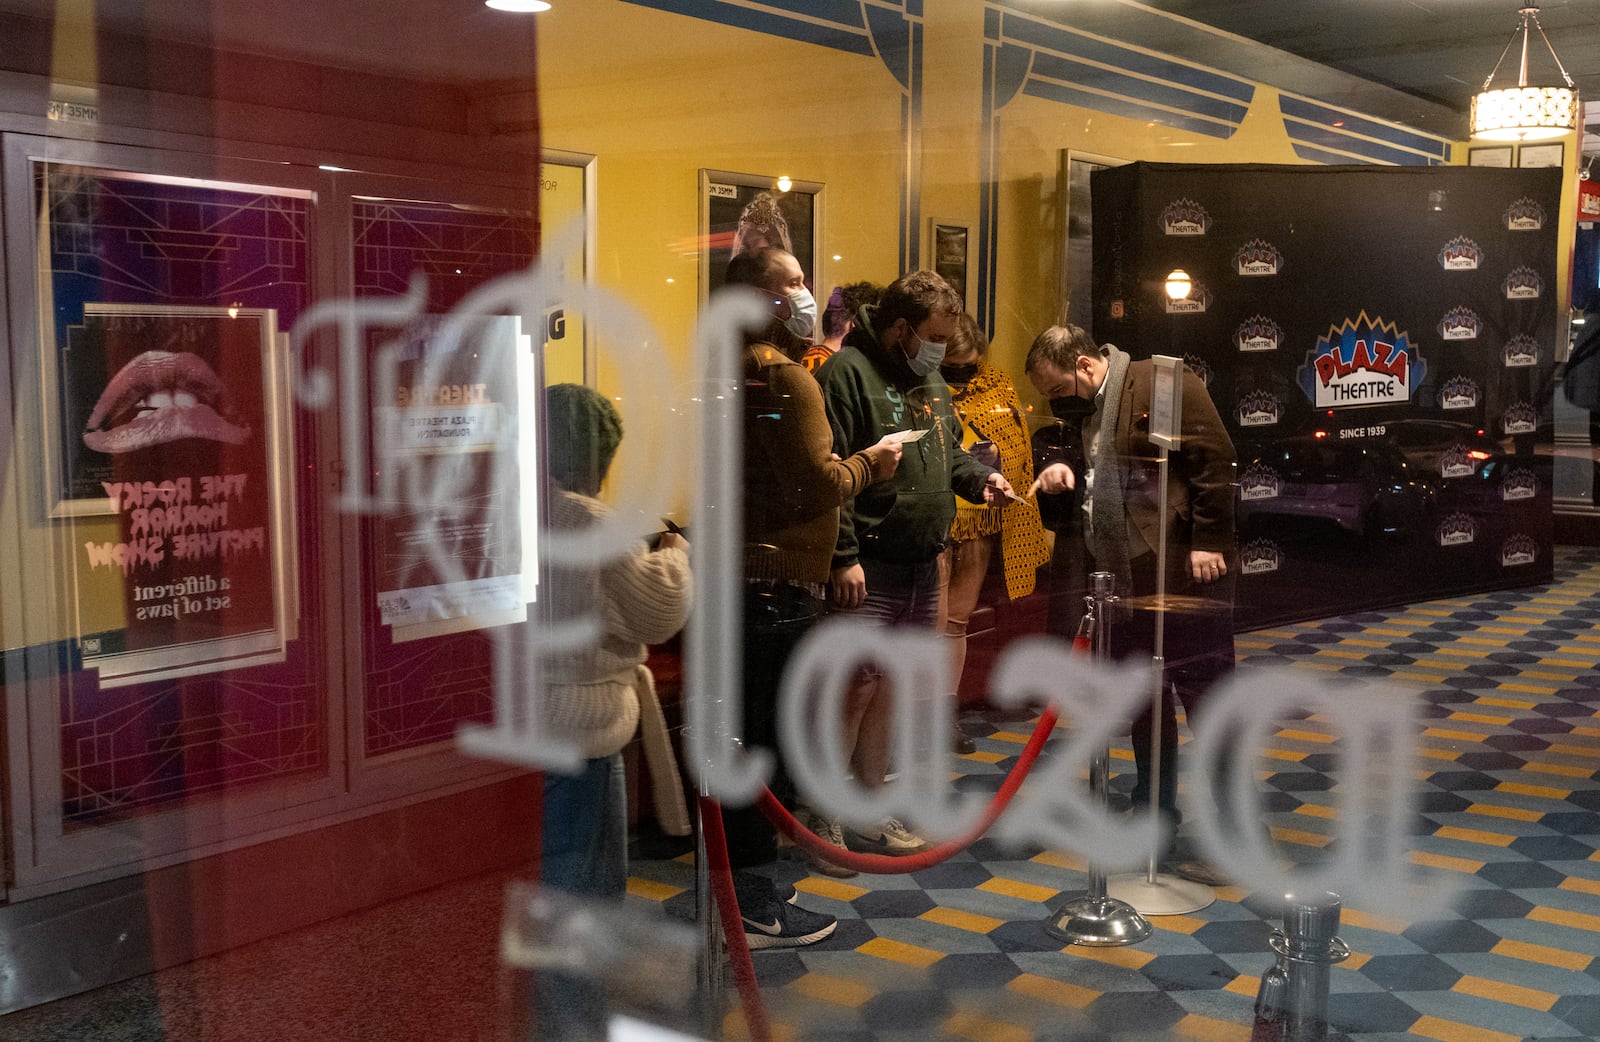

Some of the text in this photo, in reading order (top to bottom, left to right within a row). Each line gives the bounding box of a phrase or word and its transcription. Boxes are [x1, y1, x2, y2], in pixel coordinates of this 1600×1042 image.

[1172, 225, 1199, 233] THEATRE
[1244, 265, 1272, 273] THEATRE
[1172, 303, 1200, 311] THEATRE
[1245, 341, 1272, 349] THEATRE
[1313, 339, 1408, 389] PLAZA
[1330, 380, 1395, 401] THEATRE
[1246, 414, 1273, 424] THEATRE
[1339, 425, 1387, 439] SINCE 1939
[1246, 488, 1273, 498] THEATRE
[1246, 561, 1273, 572] THEATRE
